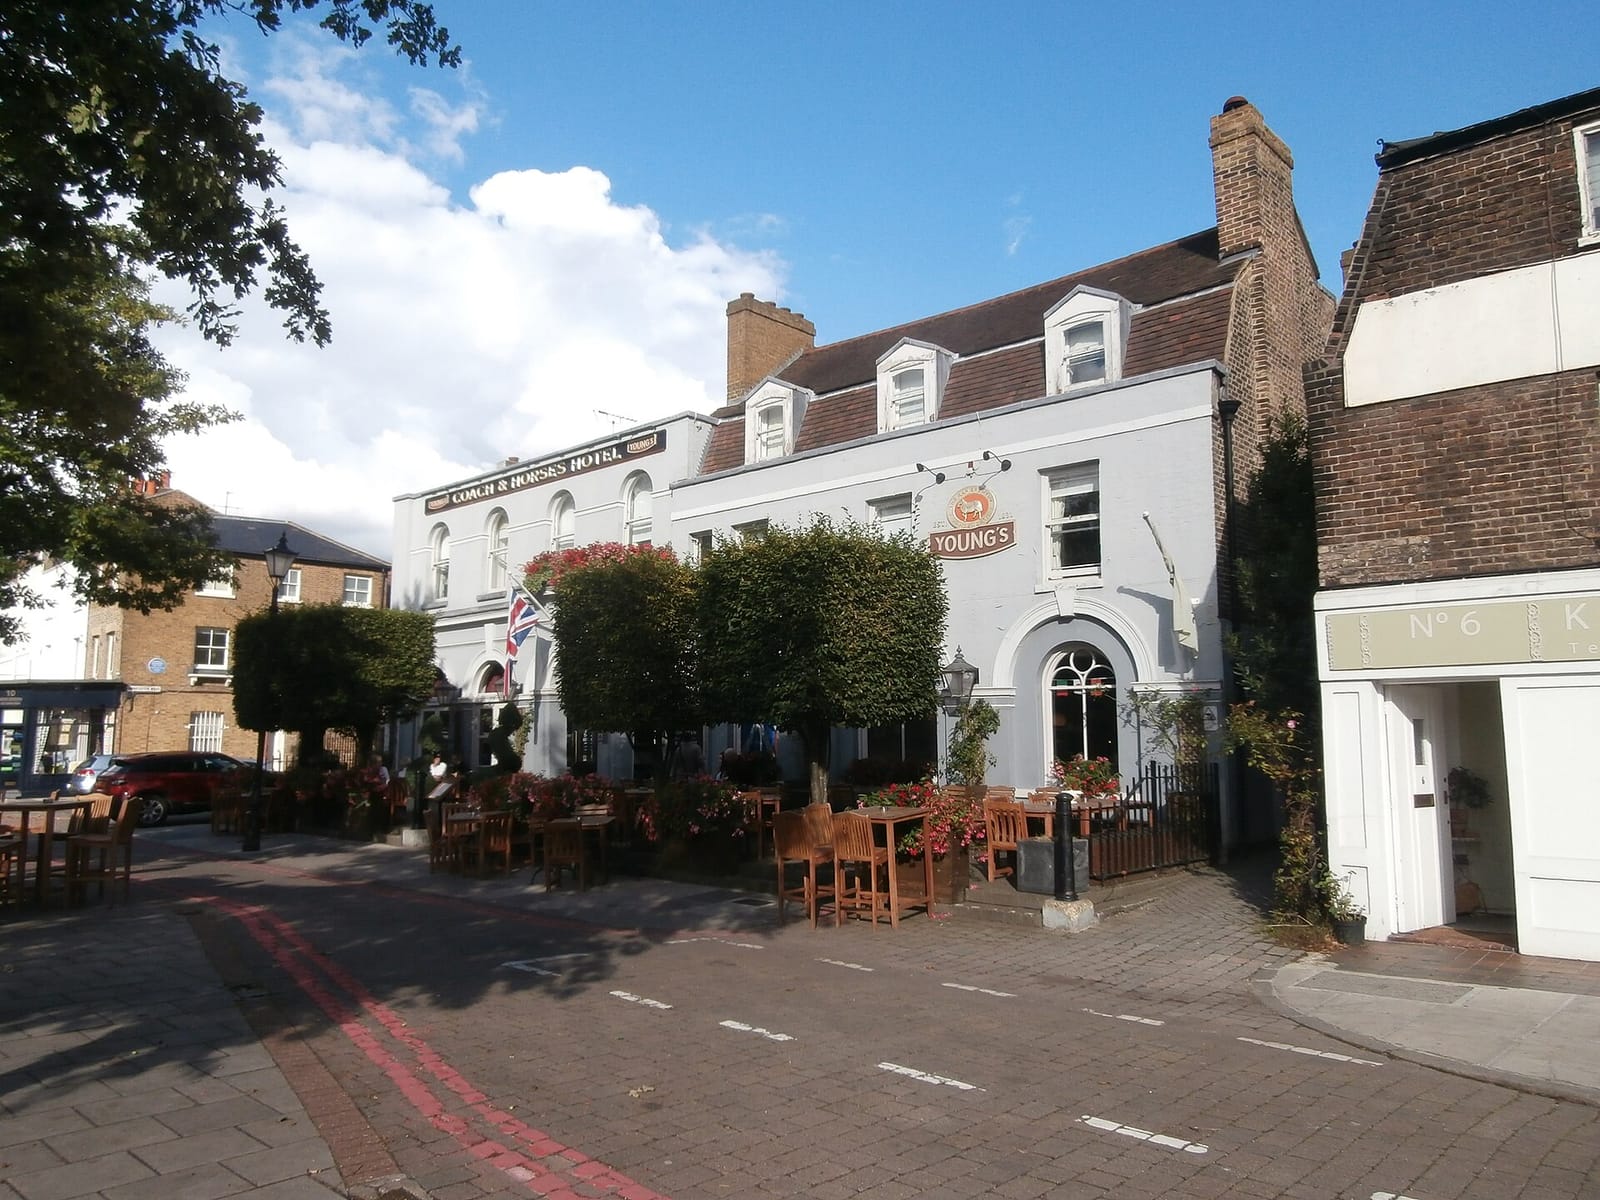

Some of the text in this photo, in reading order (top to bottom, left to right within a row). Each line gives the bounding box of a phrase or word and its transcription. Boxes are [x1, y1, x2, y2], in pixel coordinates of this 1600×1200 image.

[452, 483, 495, 505] COACH
[497, 479, 508, 491] &
[510, 461, 567, 489] HORSES
[570, 446, 622, 473] HOTEL
[935, 527, 1009, 552] YOUNG'S
[1460, 610, 1481, 636] 6
